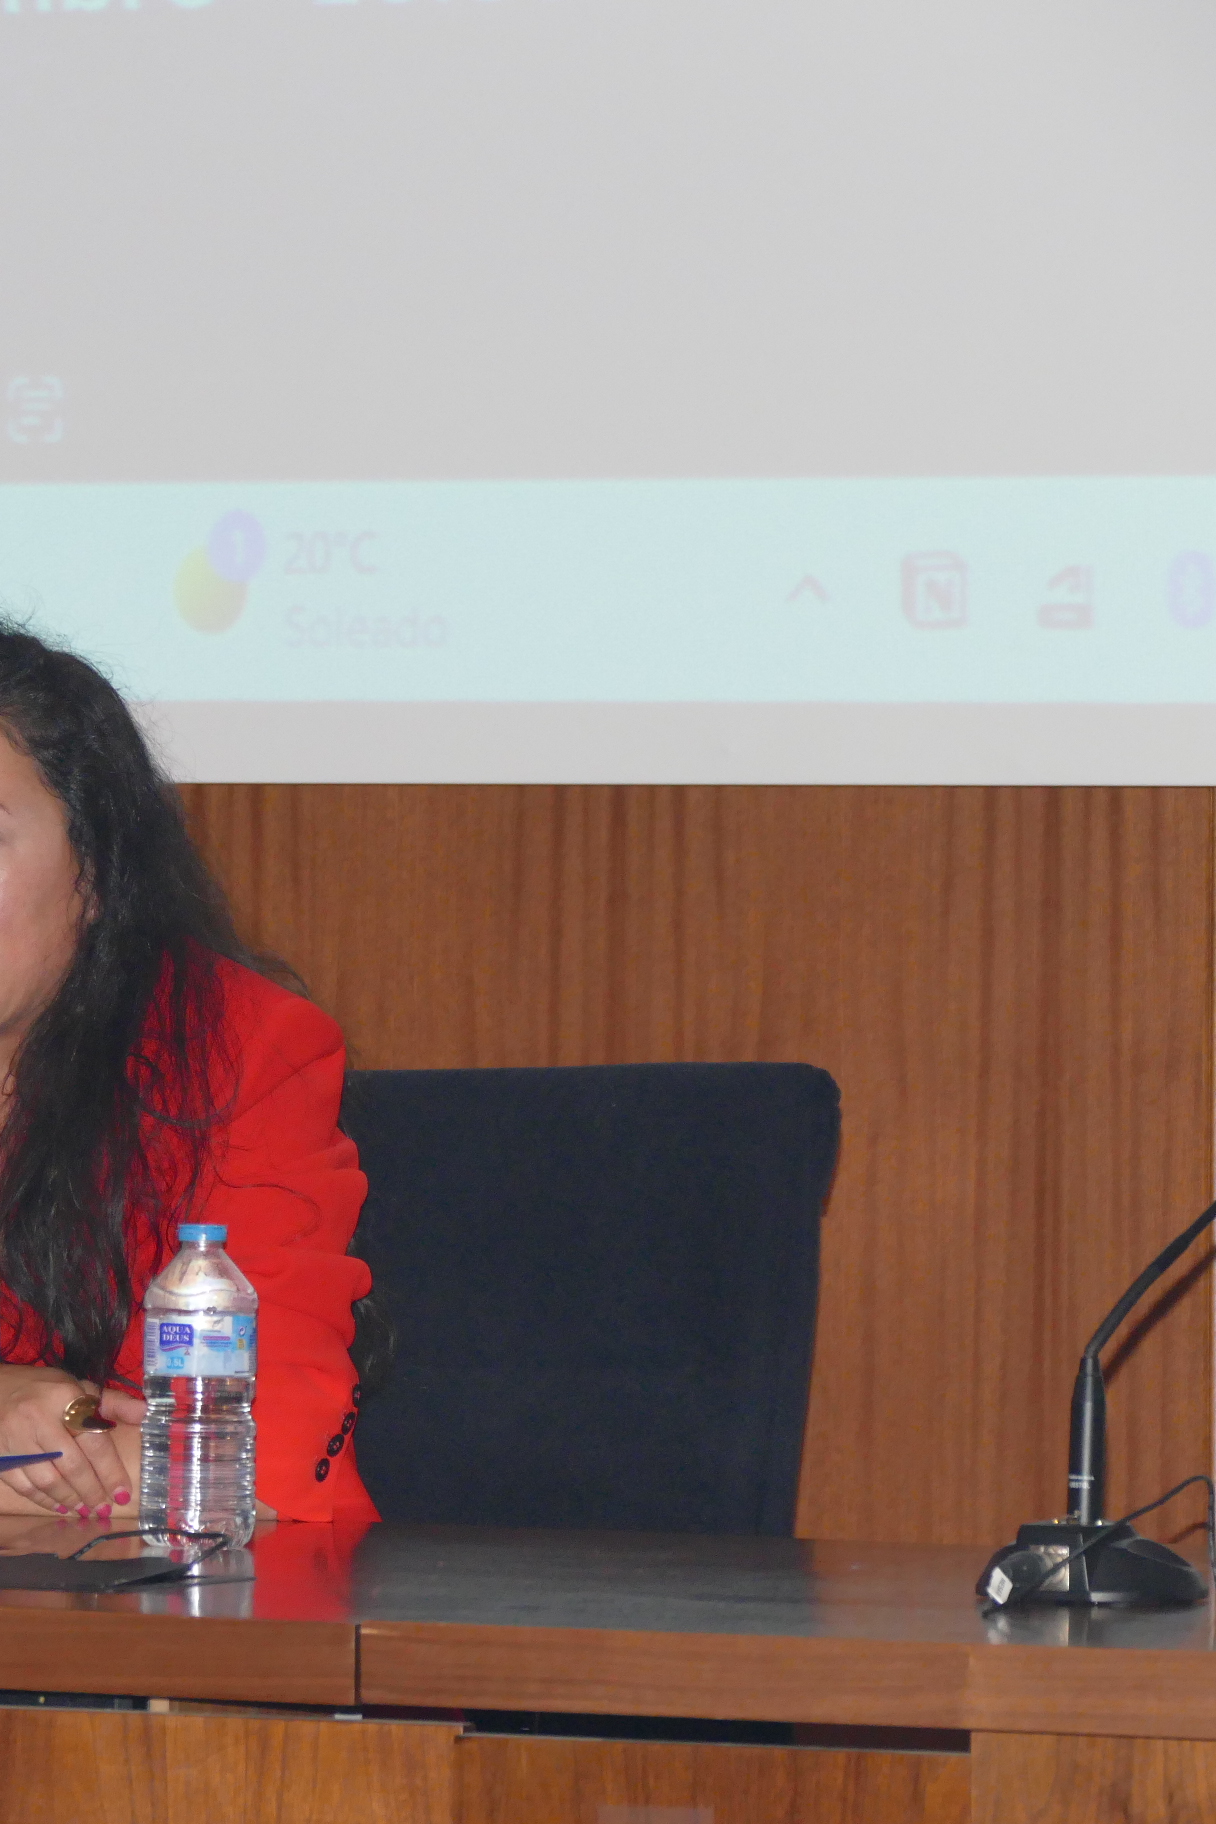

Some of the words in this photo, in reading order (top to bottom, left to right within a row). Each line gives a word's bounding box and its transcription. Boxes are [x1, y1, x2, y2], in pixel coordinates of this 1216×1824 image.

[283, 530, 380, 575] 20°C
[283, 604, 450, 649] Soleado
[162, 1325, 191, 1334] AQUA
[163, 1334, 190, 1342] DEUS
